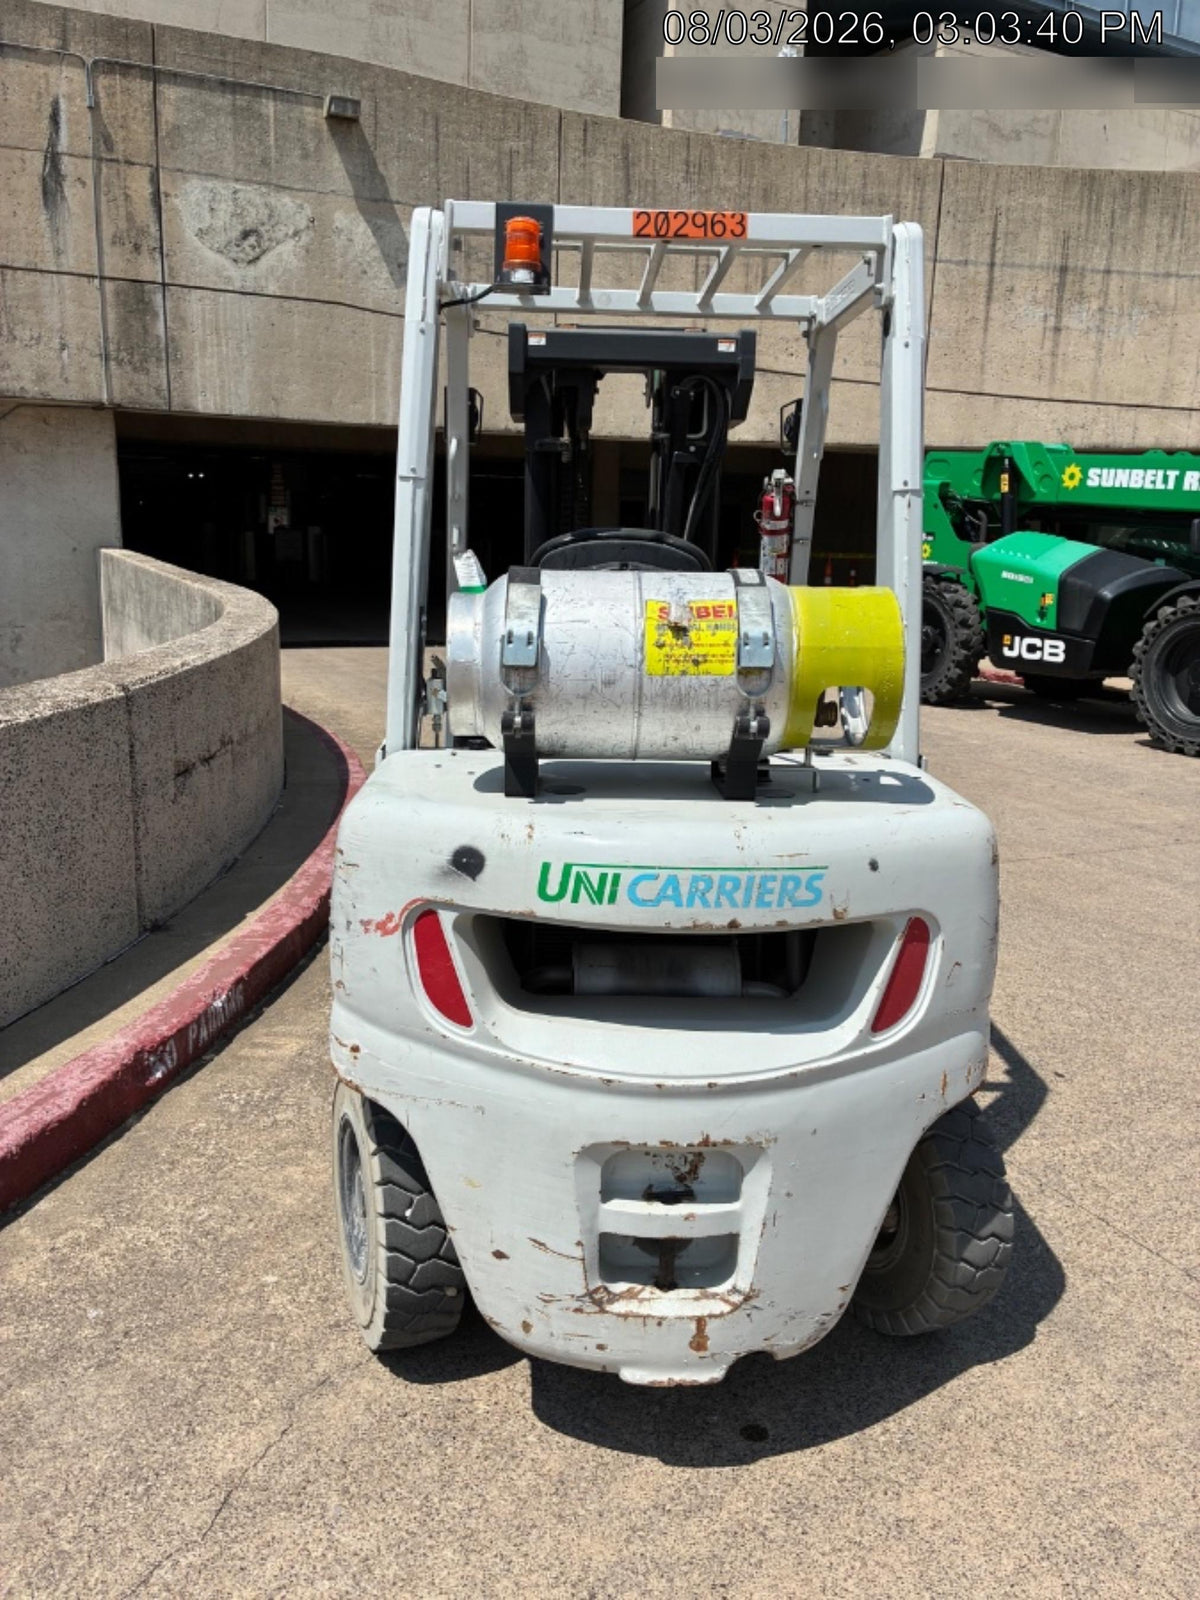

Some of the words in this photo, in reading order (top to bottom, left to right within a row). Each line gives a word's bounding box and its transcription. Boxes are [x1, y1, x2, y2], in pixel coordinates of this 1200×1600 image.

[635, 211, 746, 238] 202963
[1086, 467, 1180, 490] SUNBELT
[1002, 635, 1066, 663] JCB
